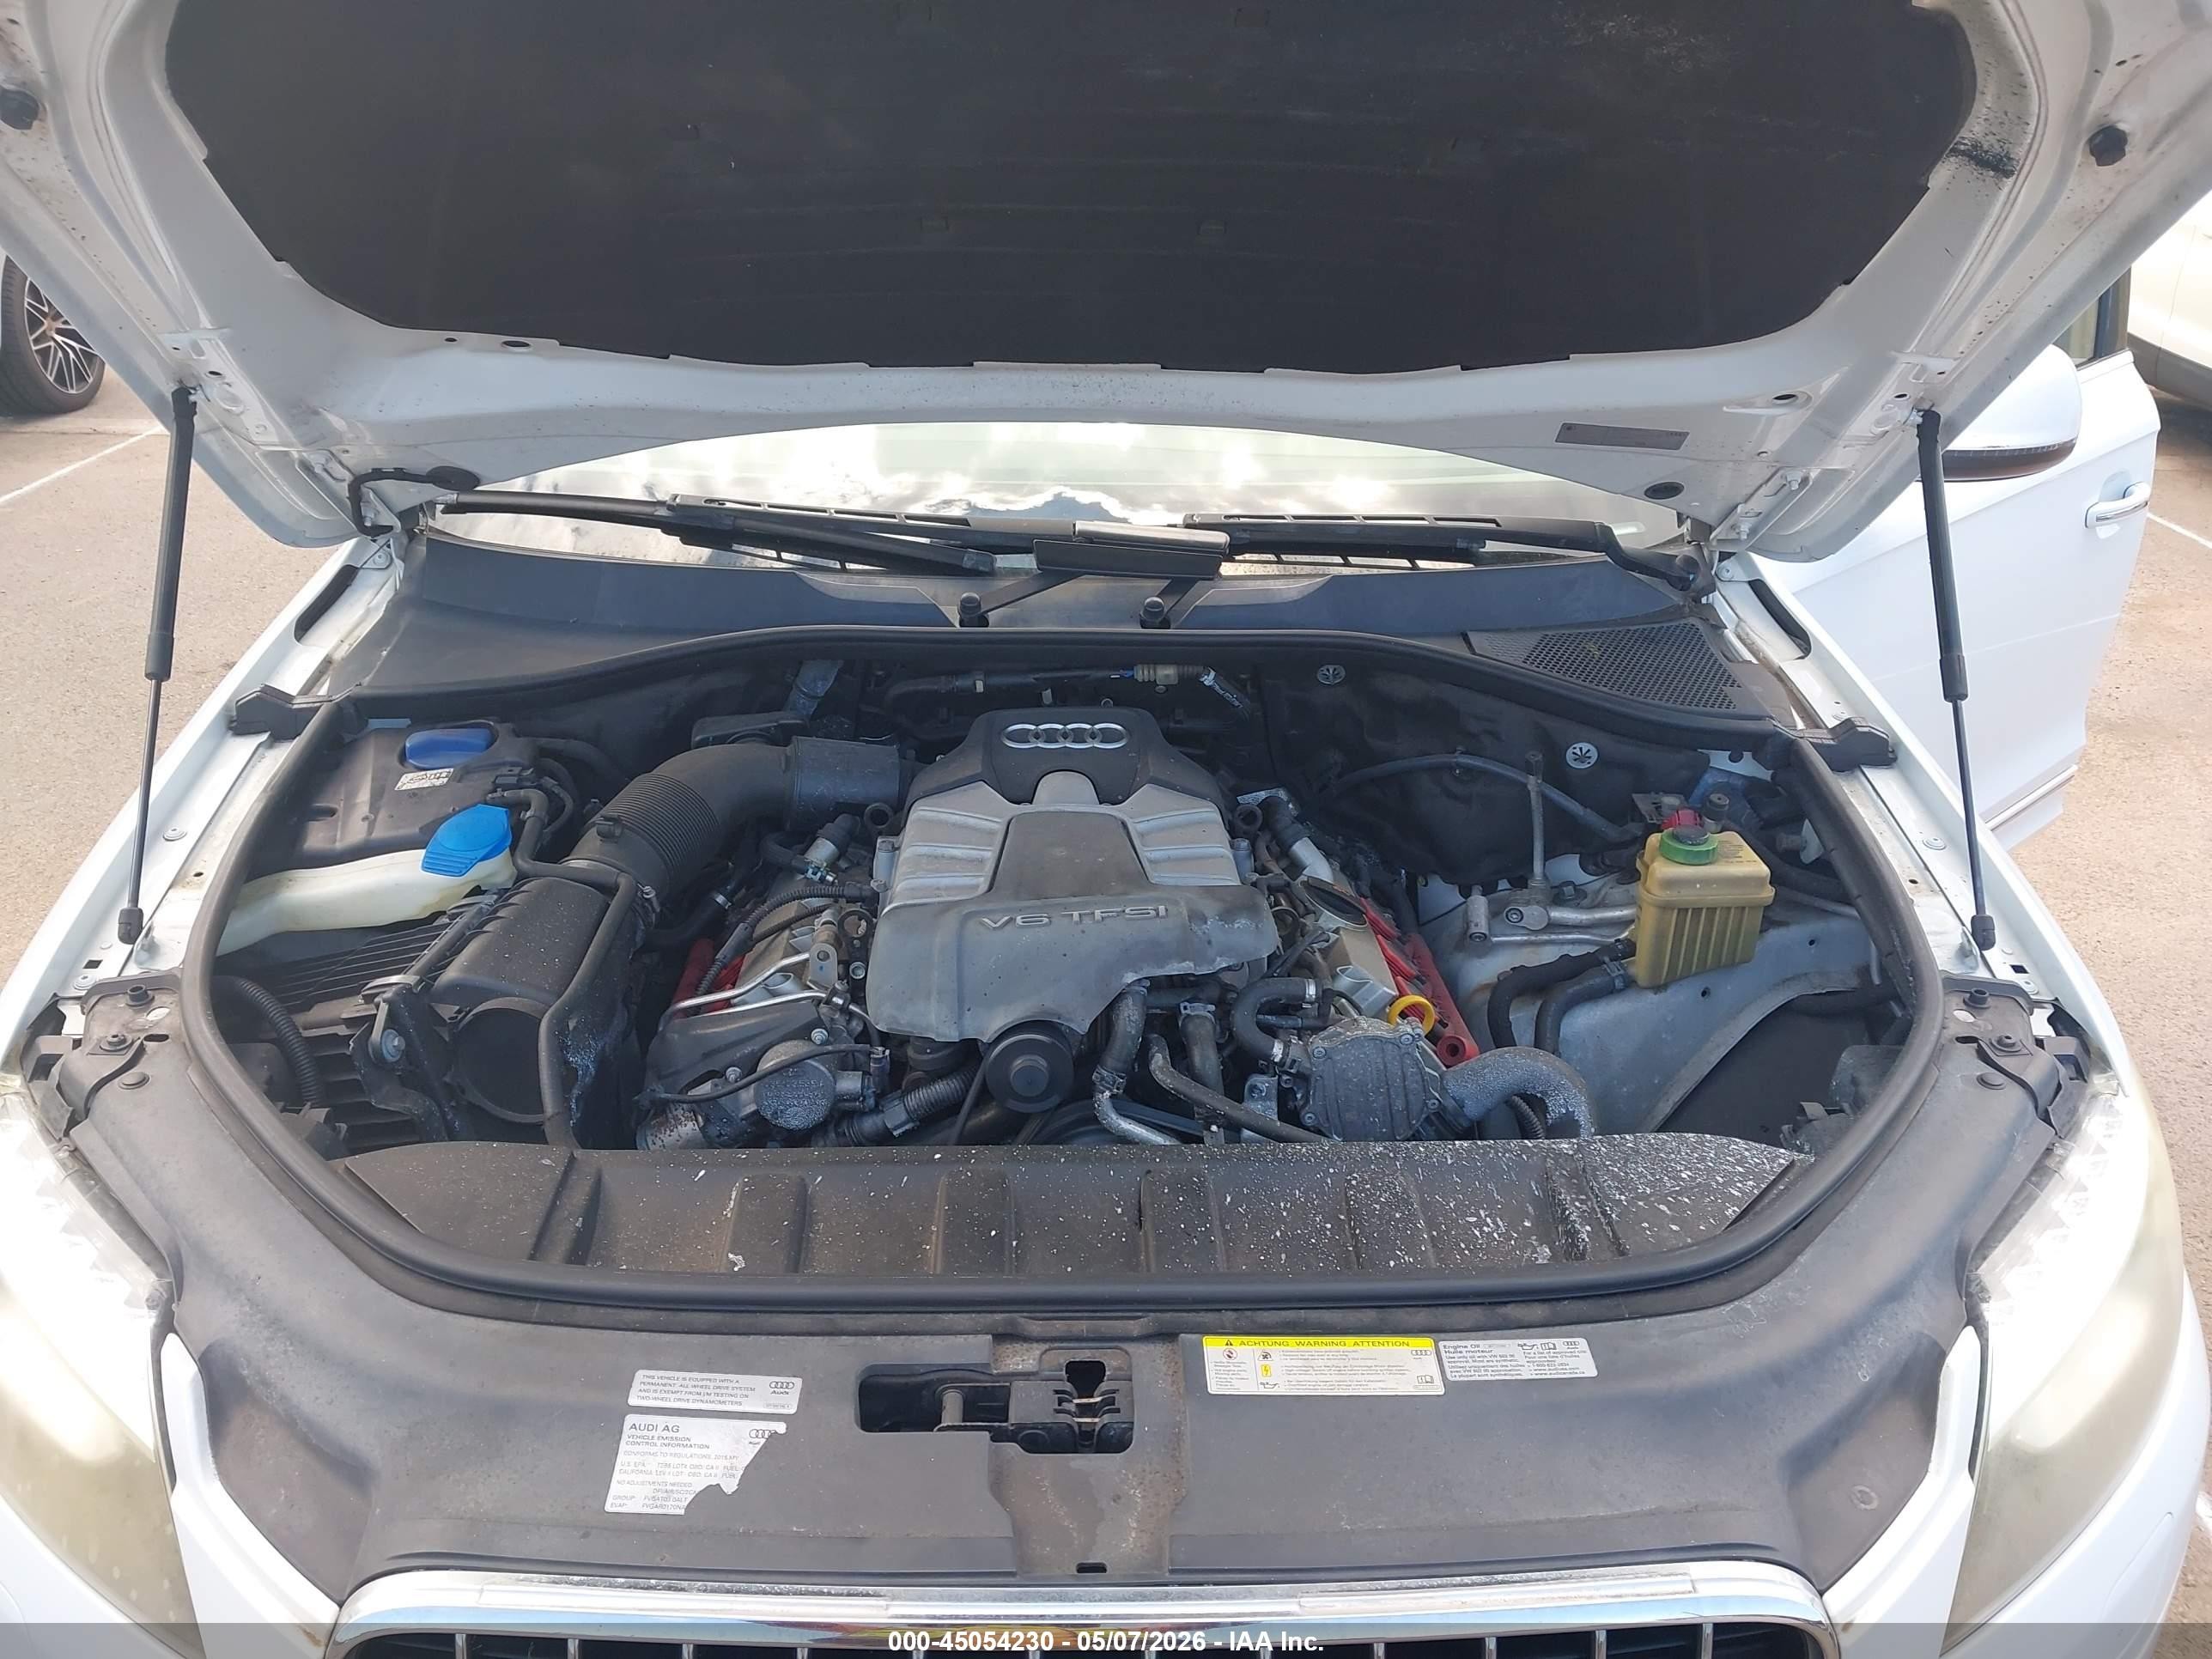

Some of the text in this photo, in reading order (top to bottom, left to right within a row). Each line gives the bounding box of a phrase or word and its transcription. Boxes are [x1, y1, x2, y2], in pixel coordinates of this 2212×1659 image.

[981, 905, 1168, 929] V6 TFSI
[692, 1398, 743, 1407] DYNAMOMETERS
[629, 1423, 680, 1433] AUDI AG
